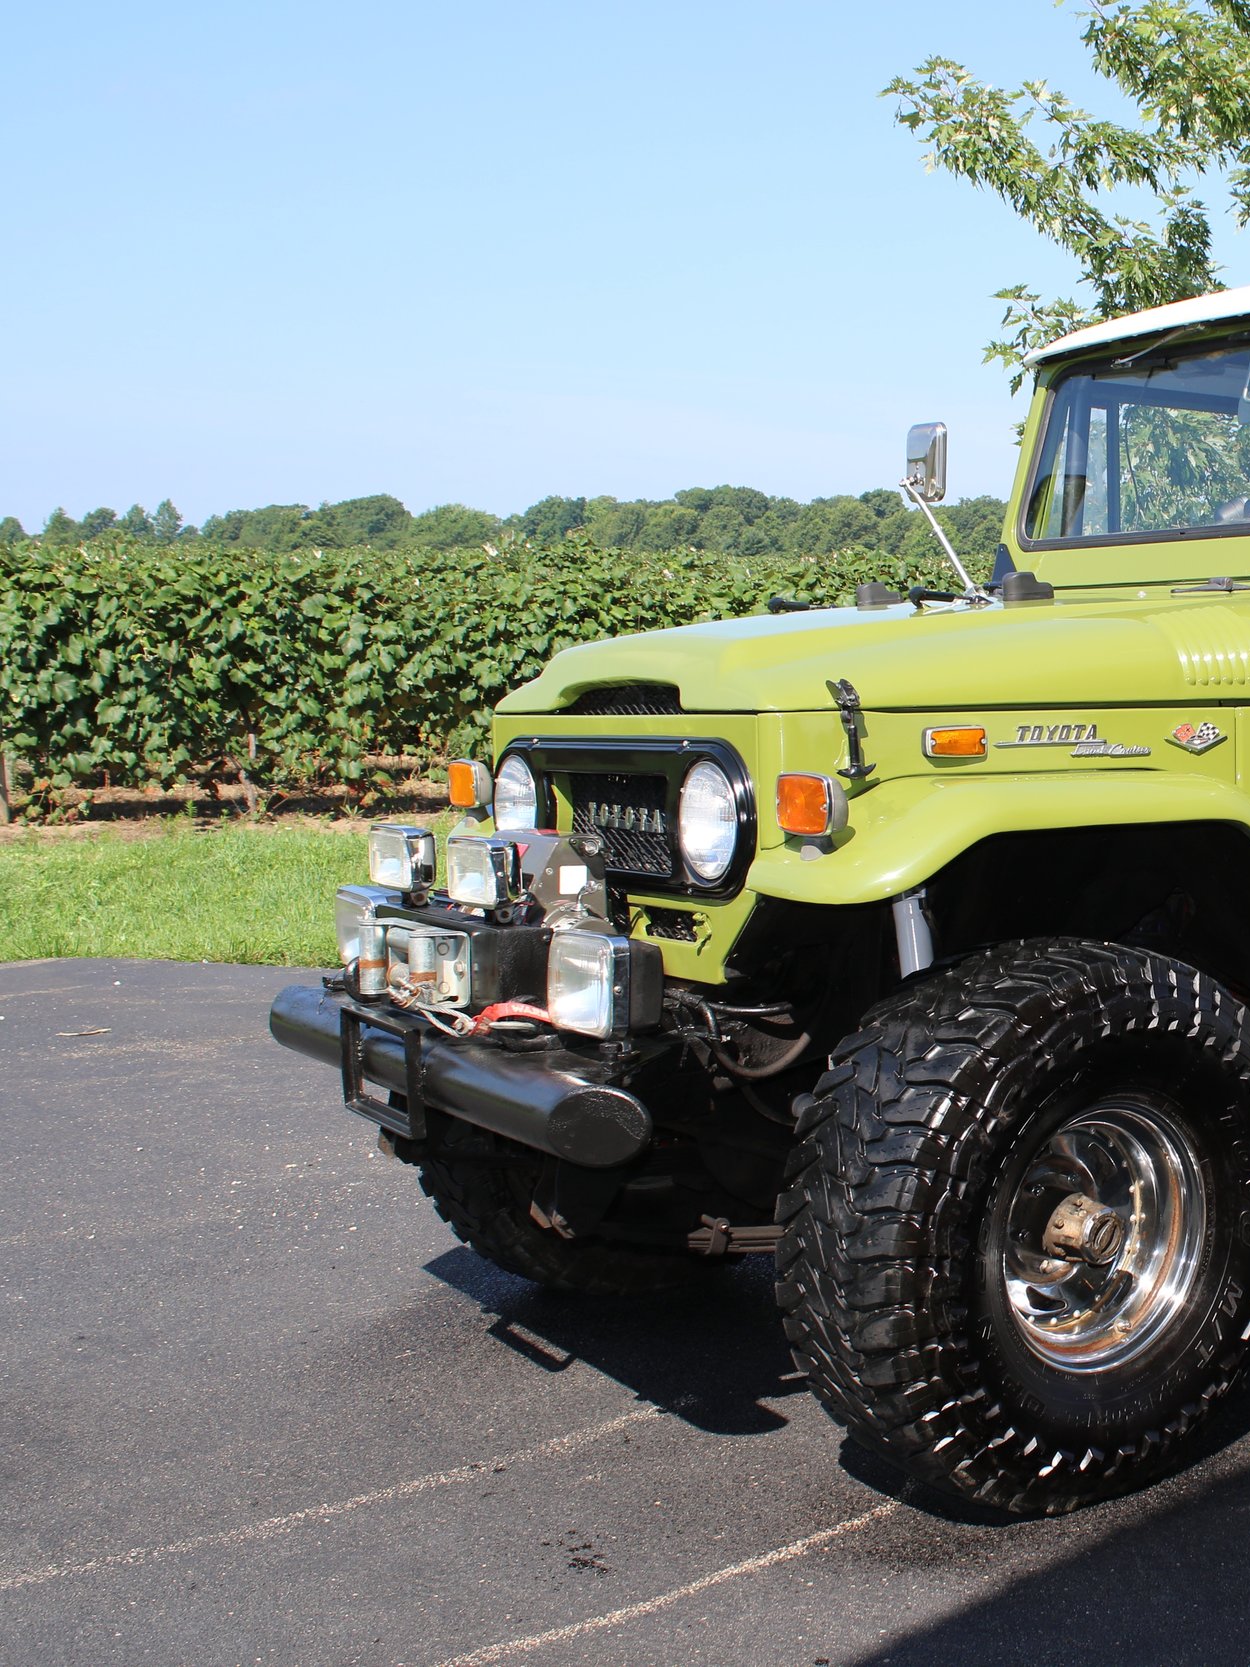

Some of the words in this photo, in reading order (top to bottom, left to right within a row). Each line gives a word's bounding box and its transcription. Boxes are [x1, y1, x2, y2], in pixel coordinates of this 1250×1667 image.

[1016, 724, 1098, 743] TOYOTA
[1073, 744, 1105, 757] Land
[1108, 744, 1151, 756] Cruiser
[588, 801, 666, 834] TOYOTA
[1194, 1275, 1245, 1369] M/T
